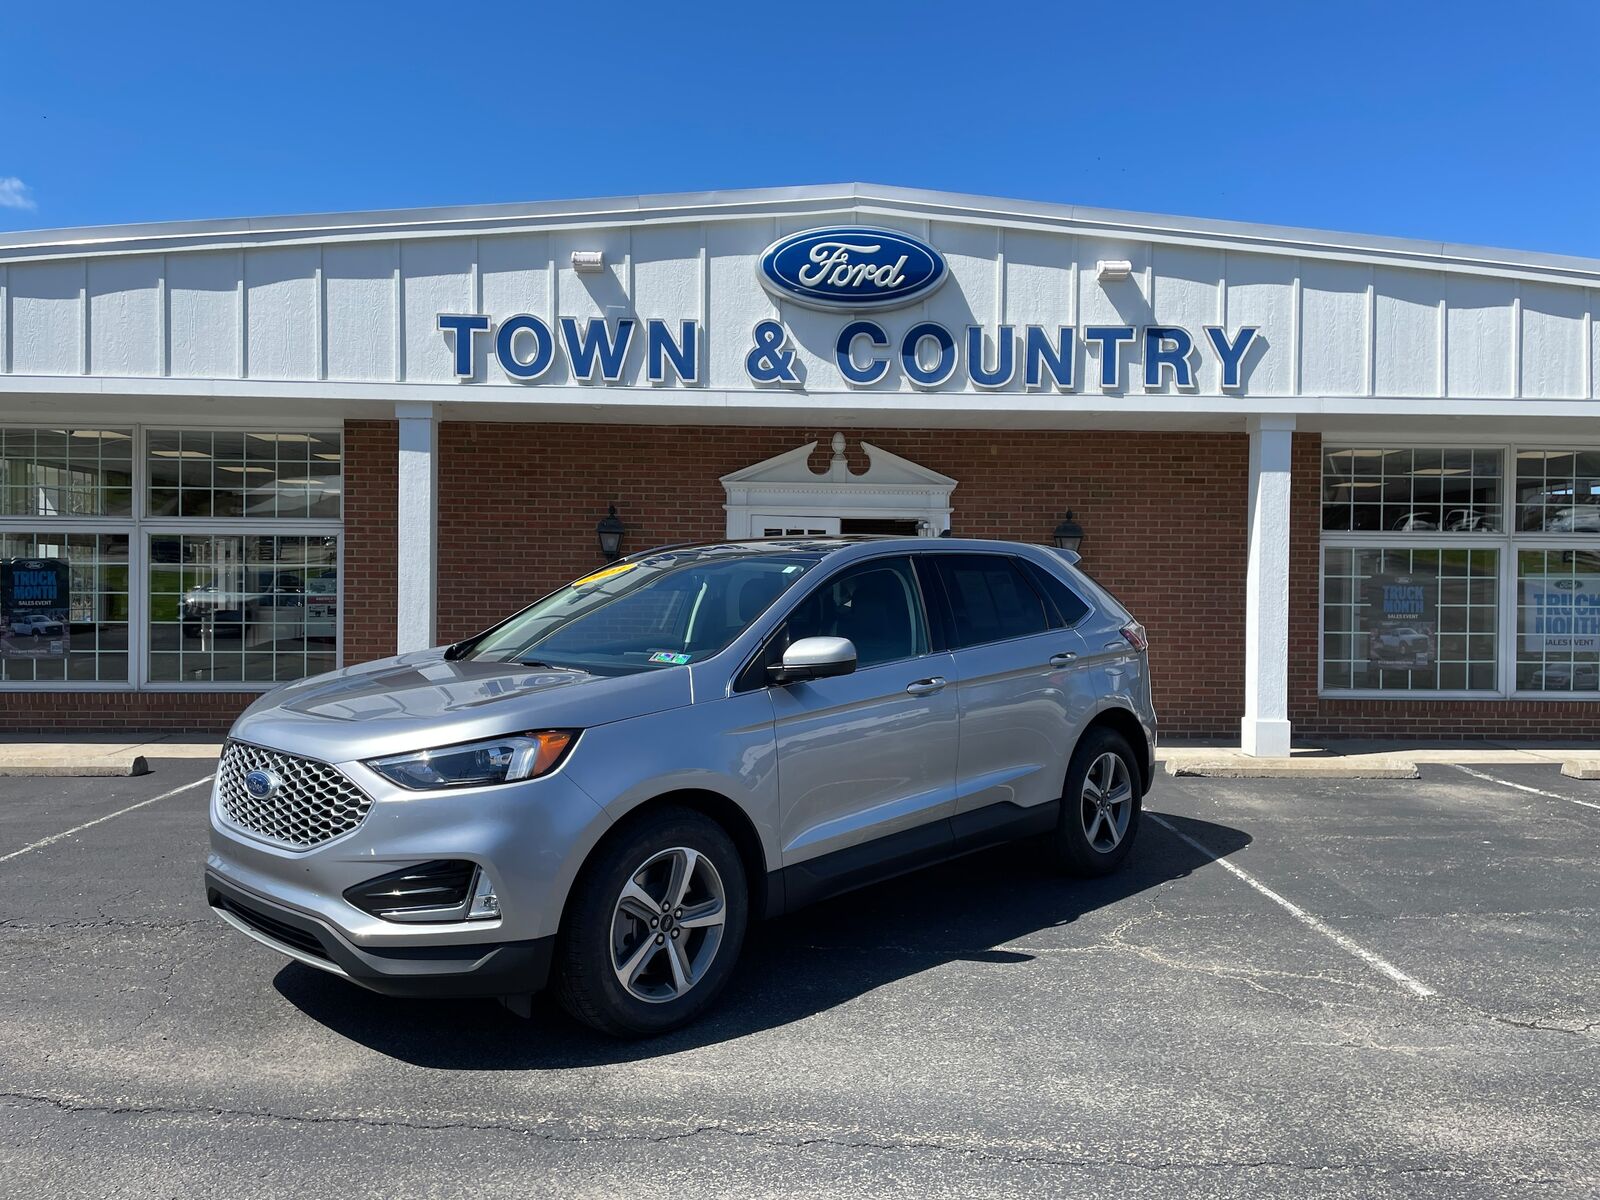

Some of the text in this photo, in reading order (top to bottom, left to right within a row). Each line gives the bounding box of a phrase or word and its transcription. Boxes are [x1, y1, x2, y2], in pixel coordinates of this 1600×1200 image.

[798, 242, 909, 287] Ford
[437, 313, 1259, 389] TOWN & COUNTRY
[13, 571, 57, 586] TRUCK
[14, 586, 58, 600] MONTH
[1382, 586, 1424, 600] TRUCK
[1383, 600, 1424, 613] MONTH
